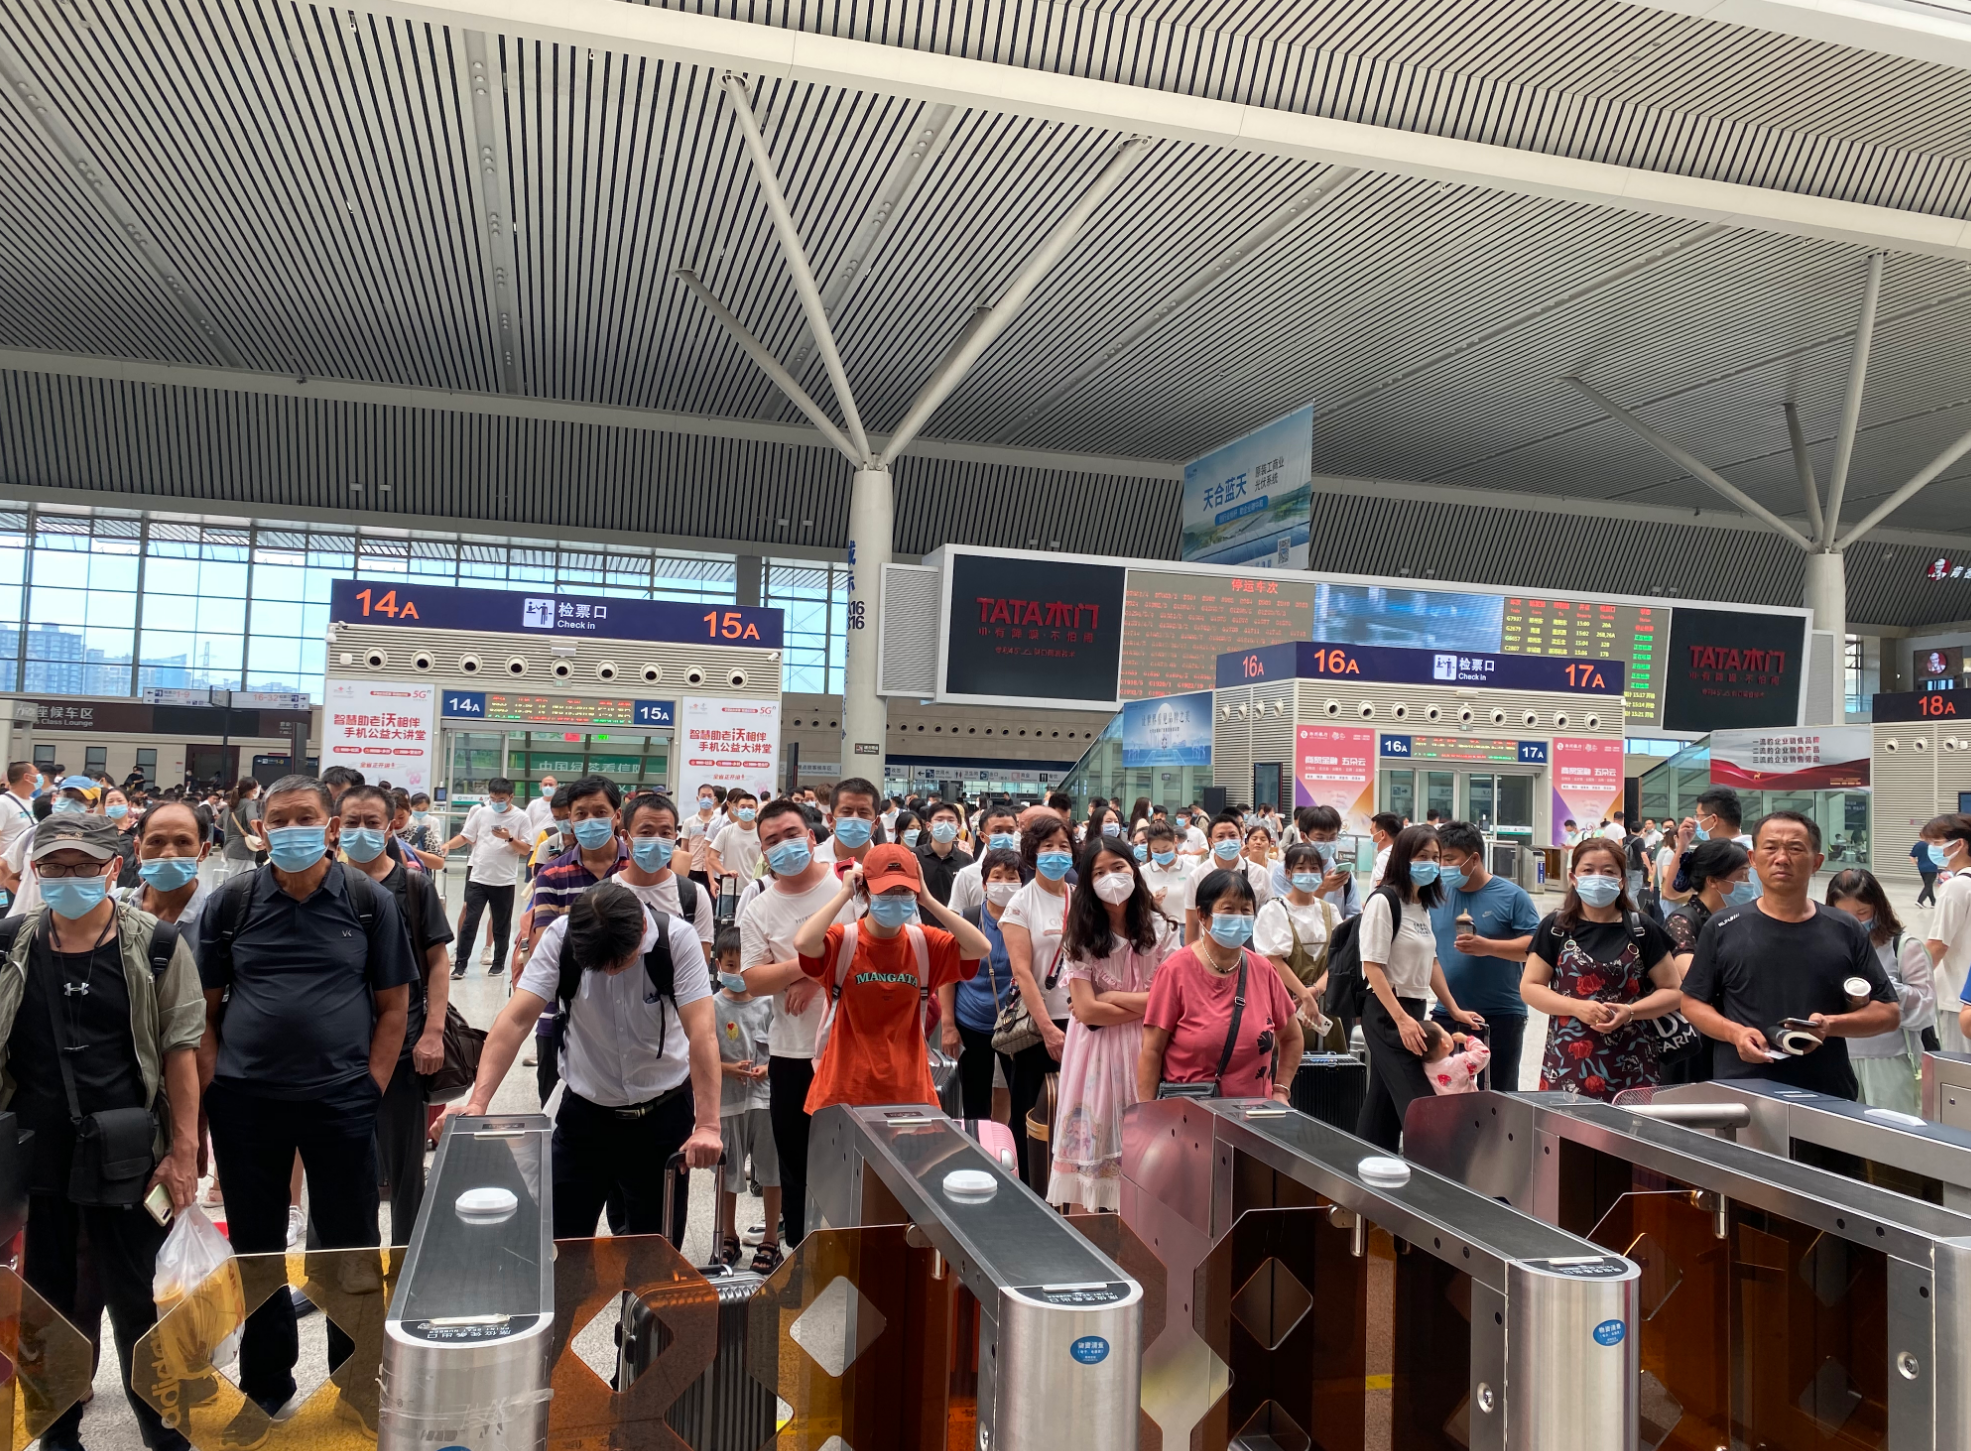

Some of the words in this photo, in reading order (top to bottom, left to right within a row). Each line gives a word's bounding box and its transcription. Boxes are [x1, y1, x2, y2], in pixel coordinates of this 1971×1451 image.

[1203, 473, 1246, 511] 天合蓝天
[1232, 578, 1278, 594] 停运车次
[356, 588, 420, 620] 14A
[558, 602, 608, 620] 检票口
[976, 597, 1100, 630] TATA木门
[557, 620, 586, 629] Check
[587, 622, 596, 630] in
[704, 611, 760, 641] 15A
[1242, 655, 1264, 678] 16A
[1314, 649, 1360, 675] 16A
[1459, 657, 1494, 672] 检票口
[1689, 645, 1785, 674] TATA木门
[1565, 664, 1606, 688] 17A
[448, 698, 480, 713] 14A
[1918, 695, 1956, 716] 18A
[640, 707, 670, 721] 15A
[344, 727, 426, 741] 手机公益大讲堂
[699, 742, 772, 754] 手机公益大讲堂
[1385, 740, 1408, 752] 16A
[1522, 747, 1544, 758] 17A
[1342, 757, 1366, 766] 五朵云
[1594, 768, 1616, 776] 五朵云
[856, 971, 918, 988] MANGATA
